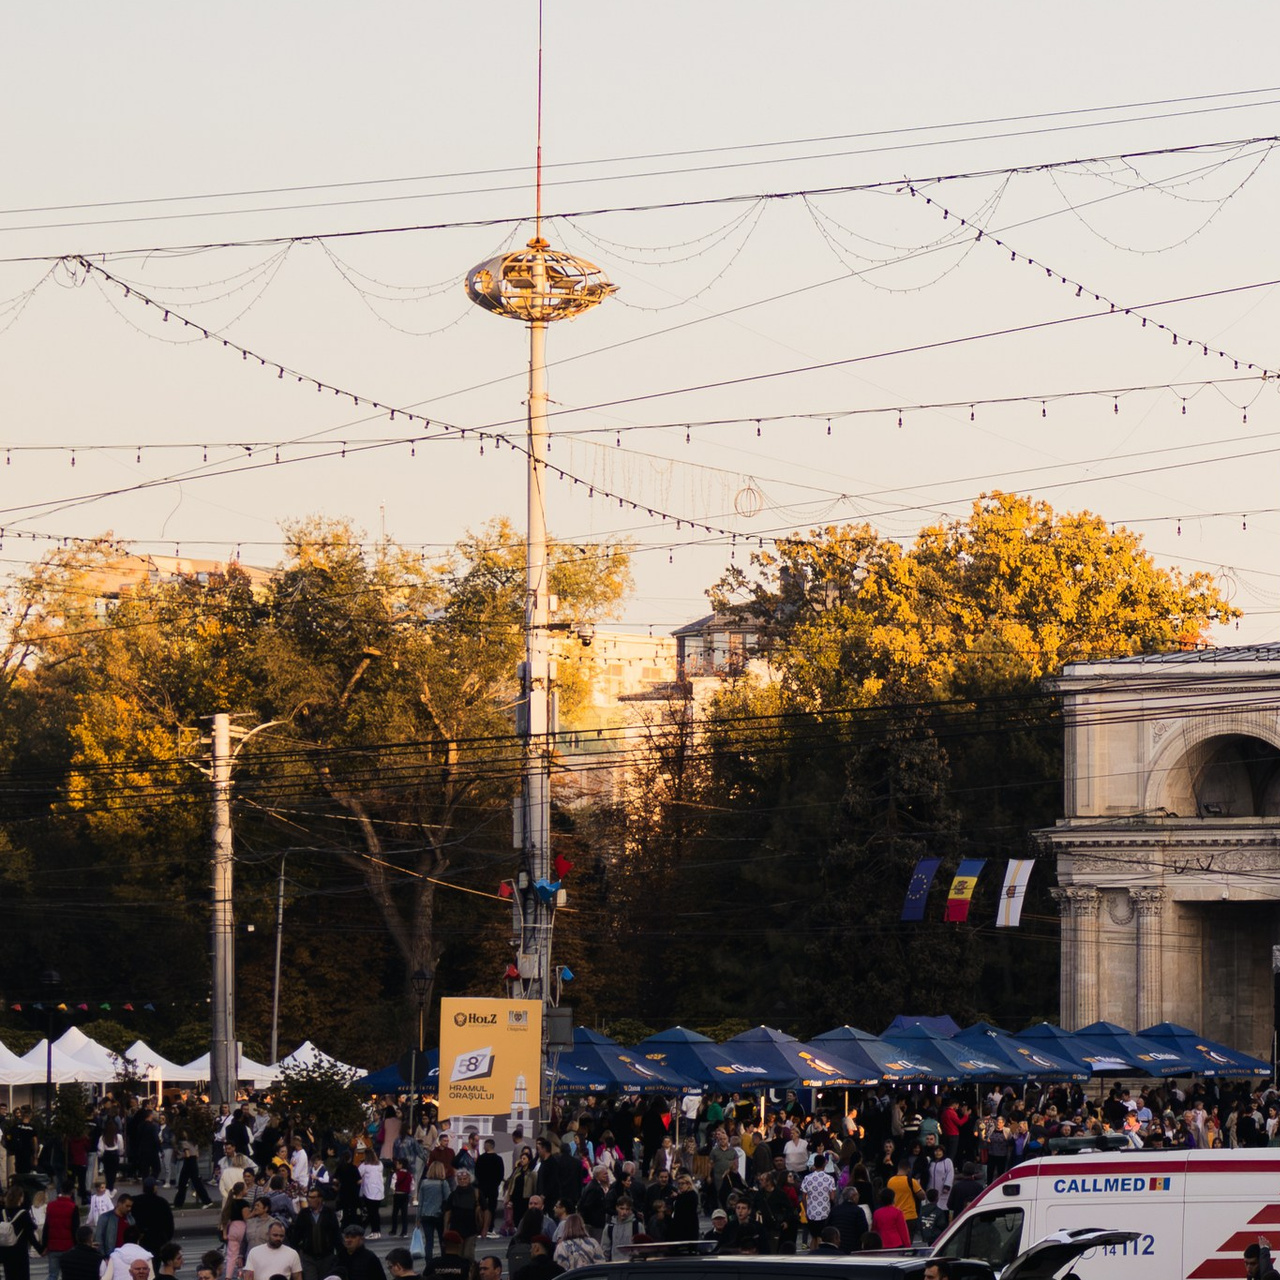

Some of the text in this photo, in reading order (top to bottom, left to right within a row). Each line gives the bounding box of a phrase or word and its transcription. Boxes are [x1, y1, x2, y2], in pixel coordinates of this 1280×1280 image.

[458, 1054, 488, 1075] 587
[449, 1084, 488, 1092] HRAMUL
[1053, 1178, 1146, 1193] CALLMED
